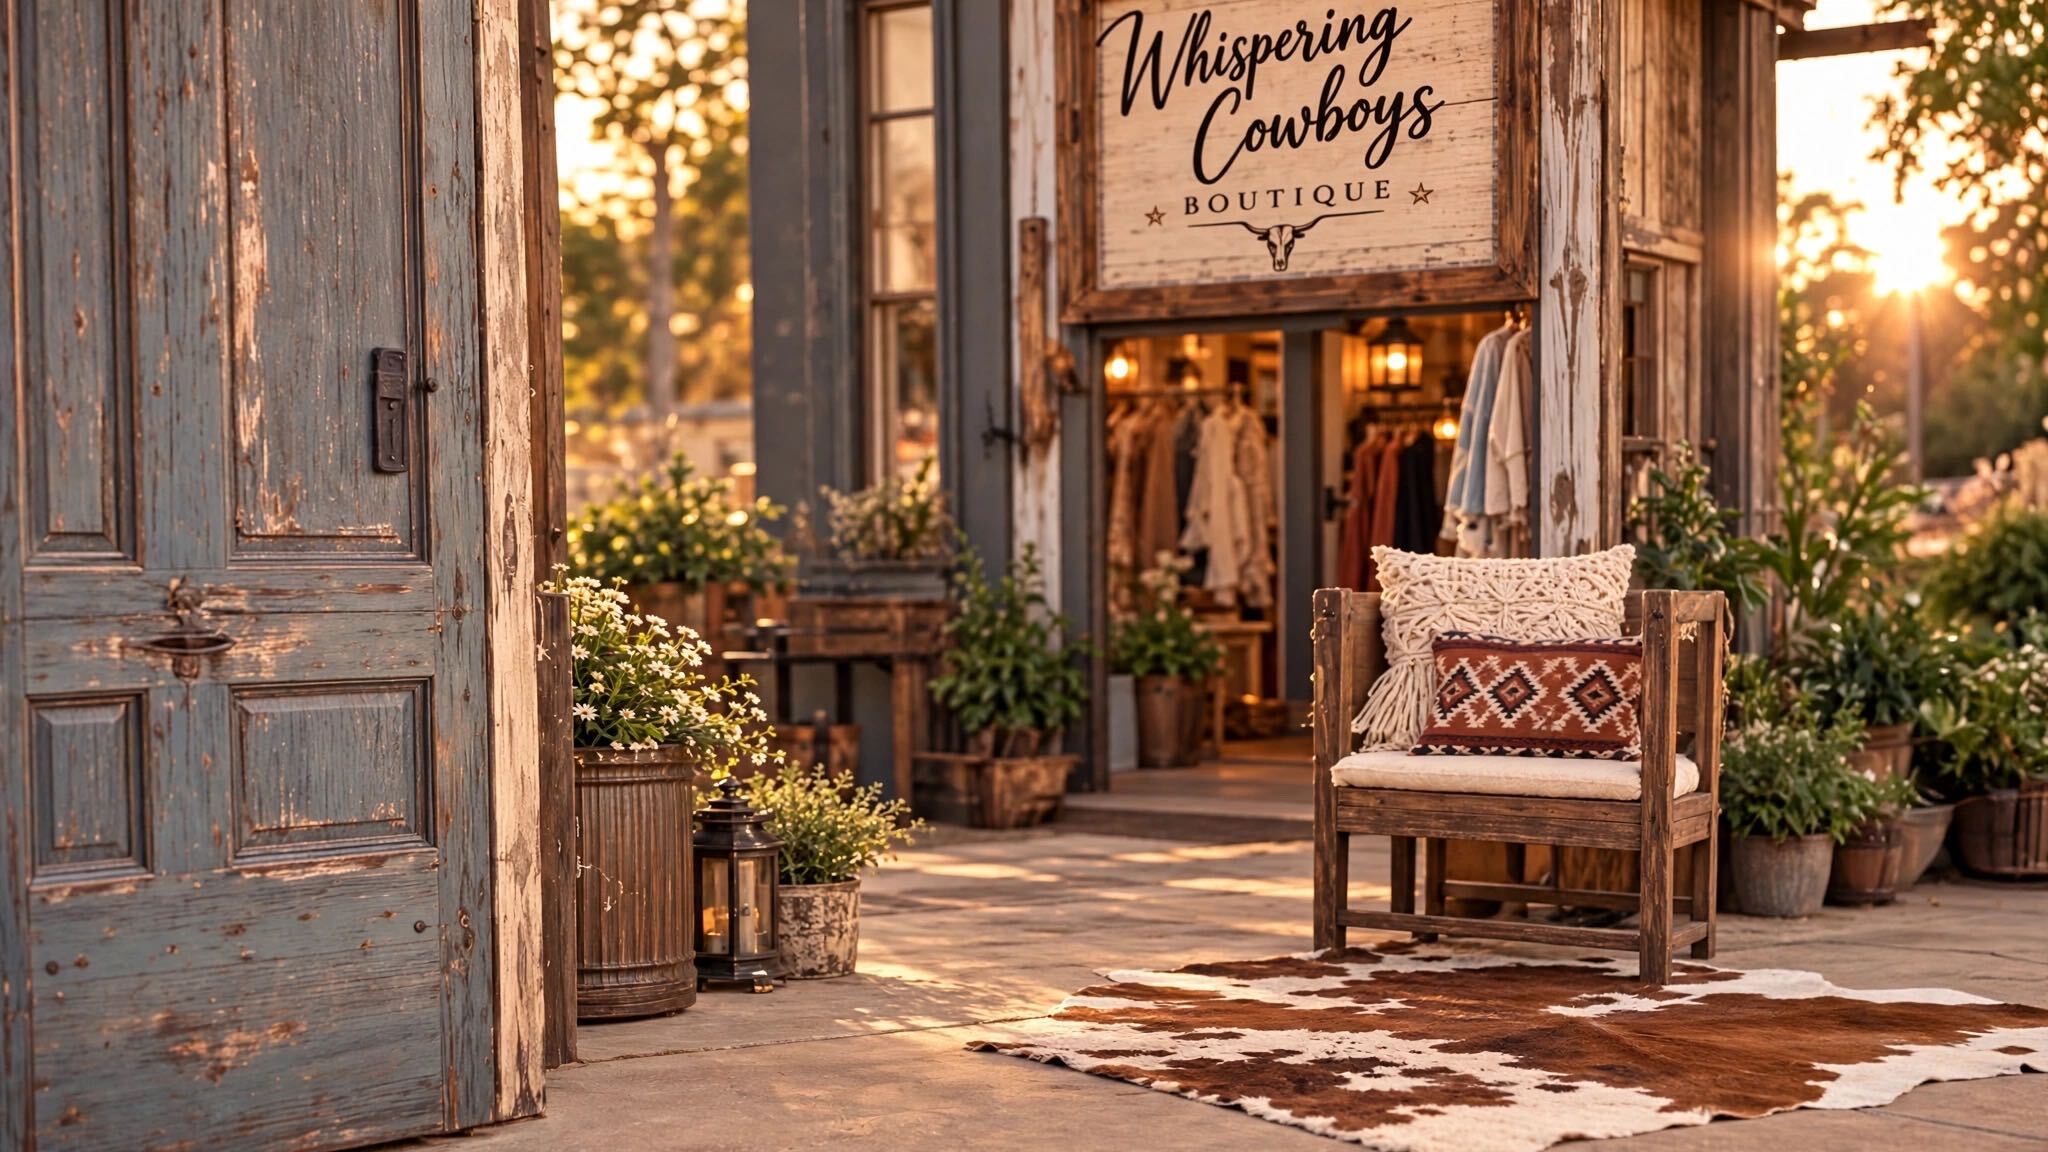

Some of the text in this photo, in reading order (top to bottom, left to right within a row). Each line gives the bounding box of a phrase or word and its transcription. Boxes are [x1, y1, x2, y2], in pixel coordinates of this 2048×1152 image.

[1096, 6, 1413, 117] Whispering
[1193, 64, 1445, 185] Cowboys
[1184, 179, 1391, 215] BOUTIQUE
